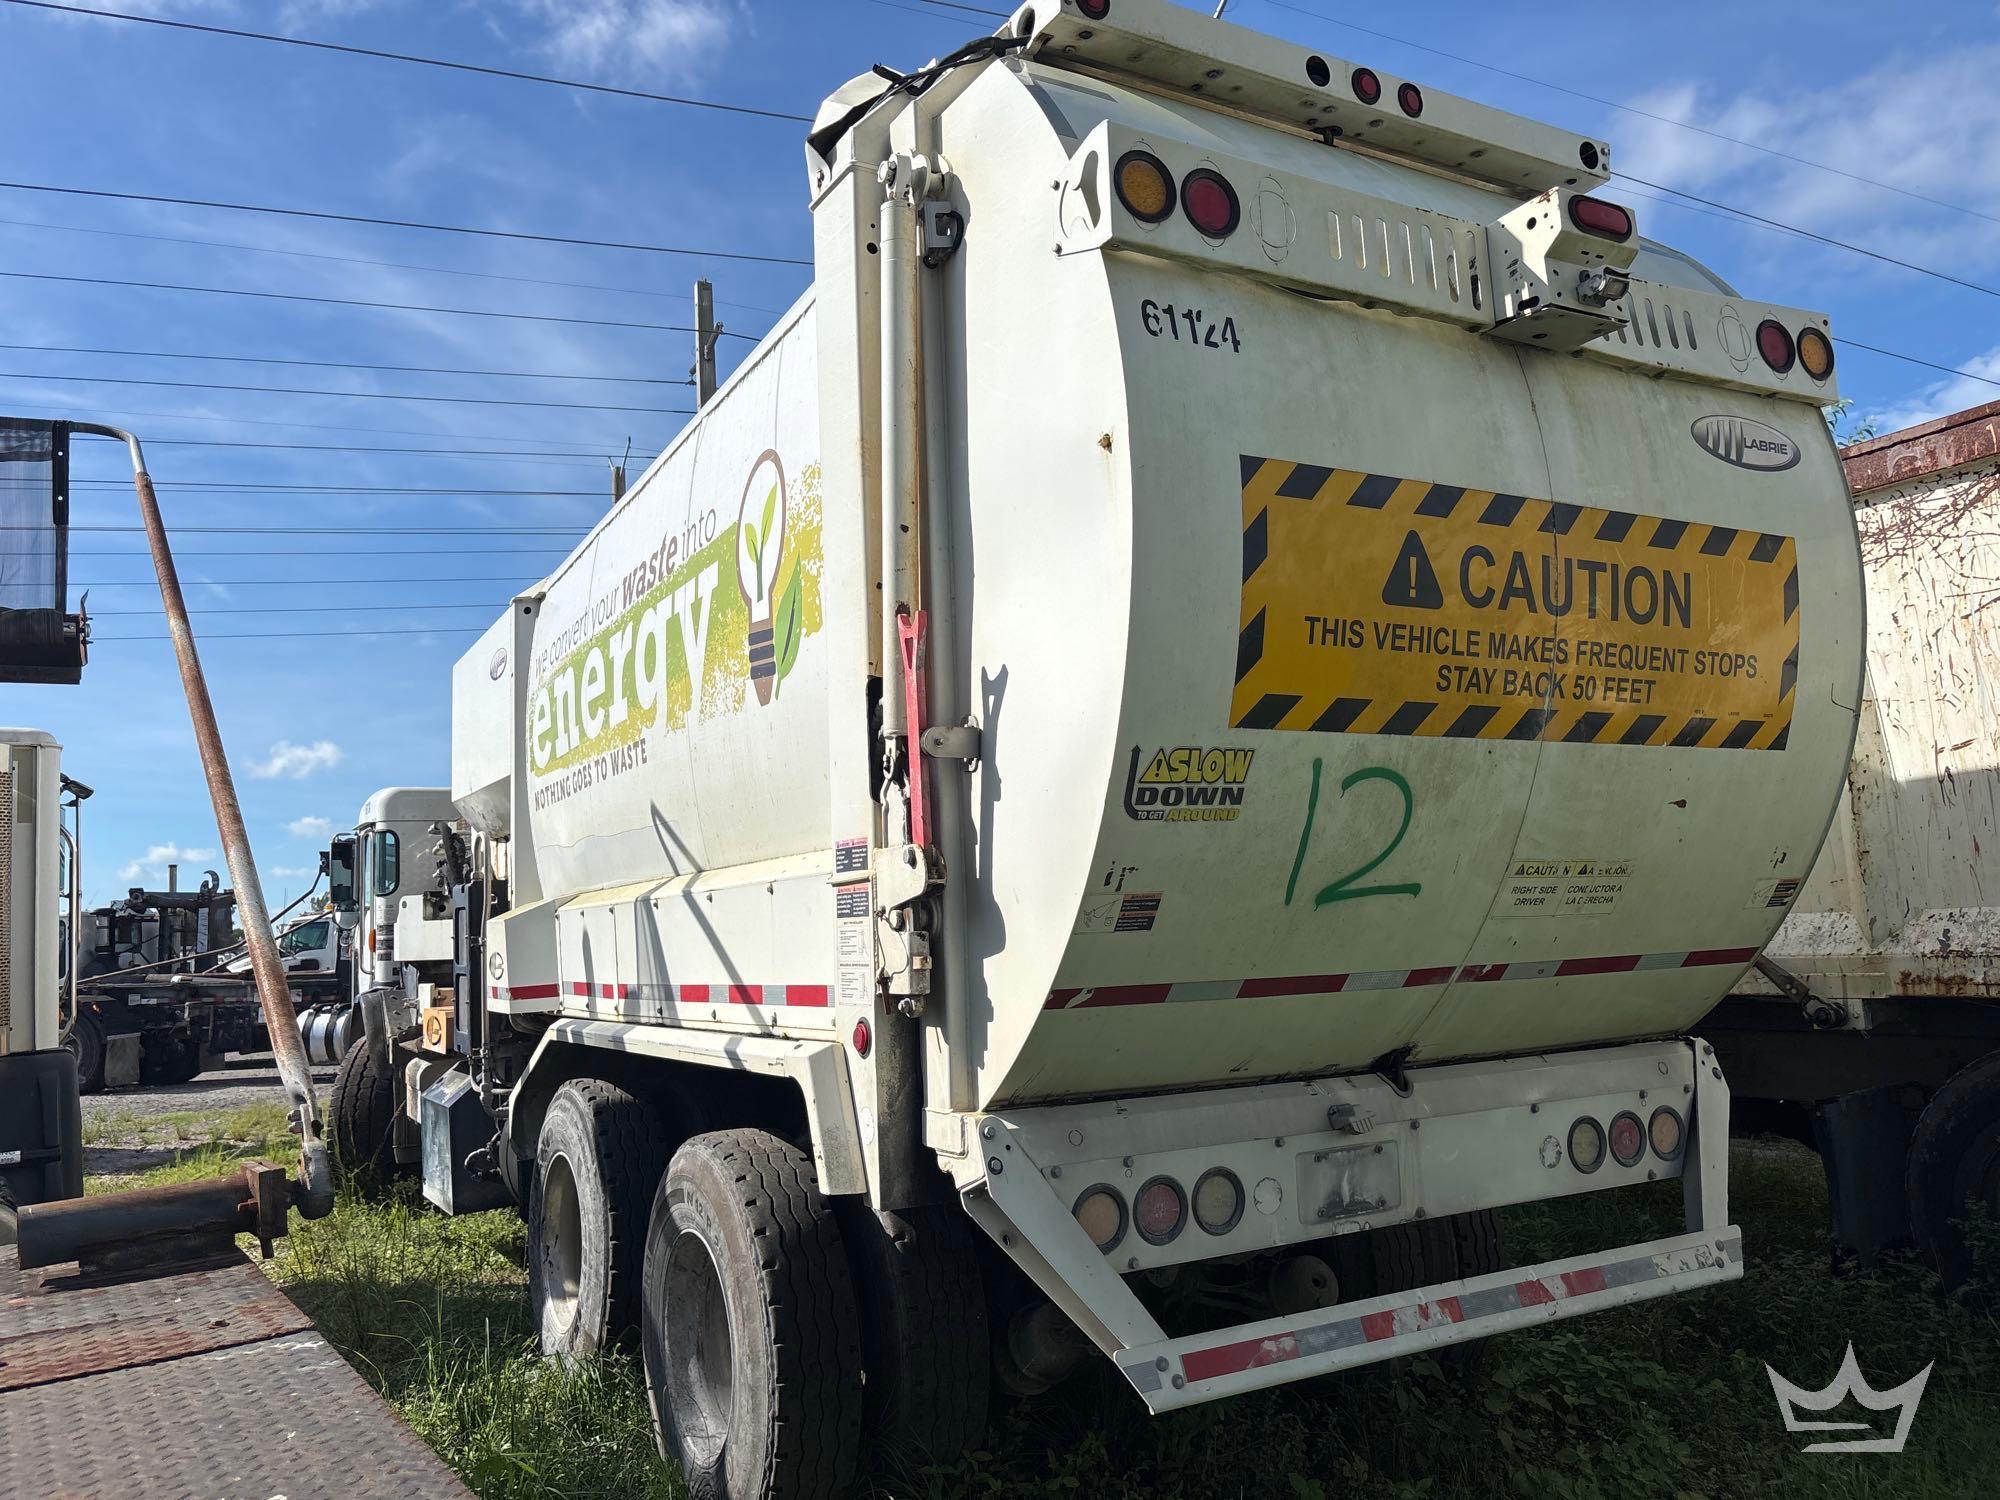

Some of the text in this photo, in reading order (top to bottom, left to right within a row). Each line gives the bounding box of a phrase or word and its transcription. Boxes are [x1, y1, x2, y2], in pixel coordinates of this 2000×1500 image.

[1140, 299, 1241, 354] 61124
[1743, 437, 1789, 456] LABRIE
[550, 609, 589, 664] convert
[590, 582, 620, 642] your
[622, 531, 678, 609] waste
[682, 508, 717, 561] into
[1459, 544, 1692, 629] CAUTION
[532, 560, 719, 770] energy
[1304, 615, 1758, 679] THIS VEHICLE MAKES FREQUENT STOPS
[1436, 664, 1657, 705] STAY BACK 50 FEET
[534, 737, 648, 812] NOTHING GOES TO WASTE
[1168, 747, 1255, 784] SLOW
[1135, 786, 1245, 806] DOWN
[1137, 808, 1241, 822] TO GET AROUND
[1284, 757, 1422, 912] 12
[1511, 885, 1559, 895] RIGHT SIDE
[1525, 865, 1572, 876] CAUTN
[1514, 898, 1546, 906] DRIVER
